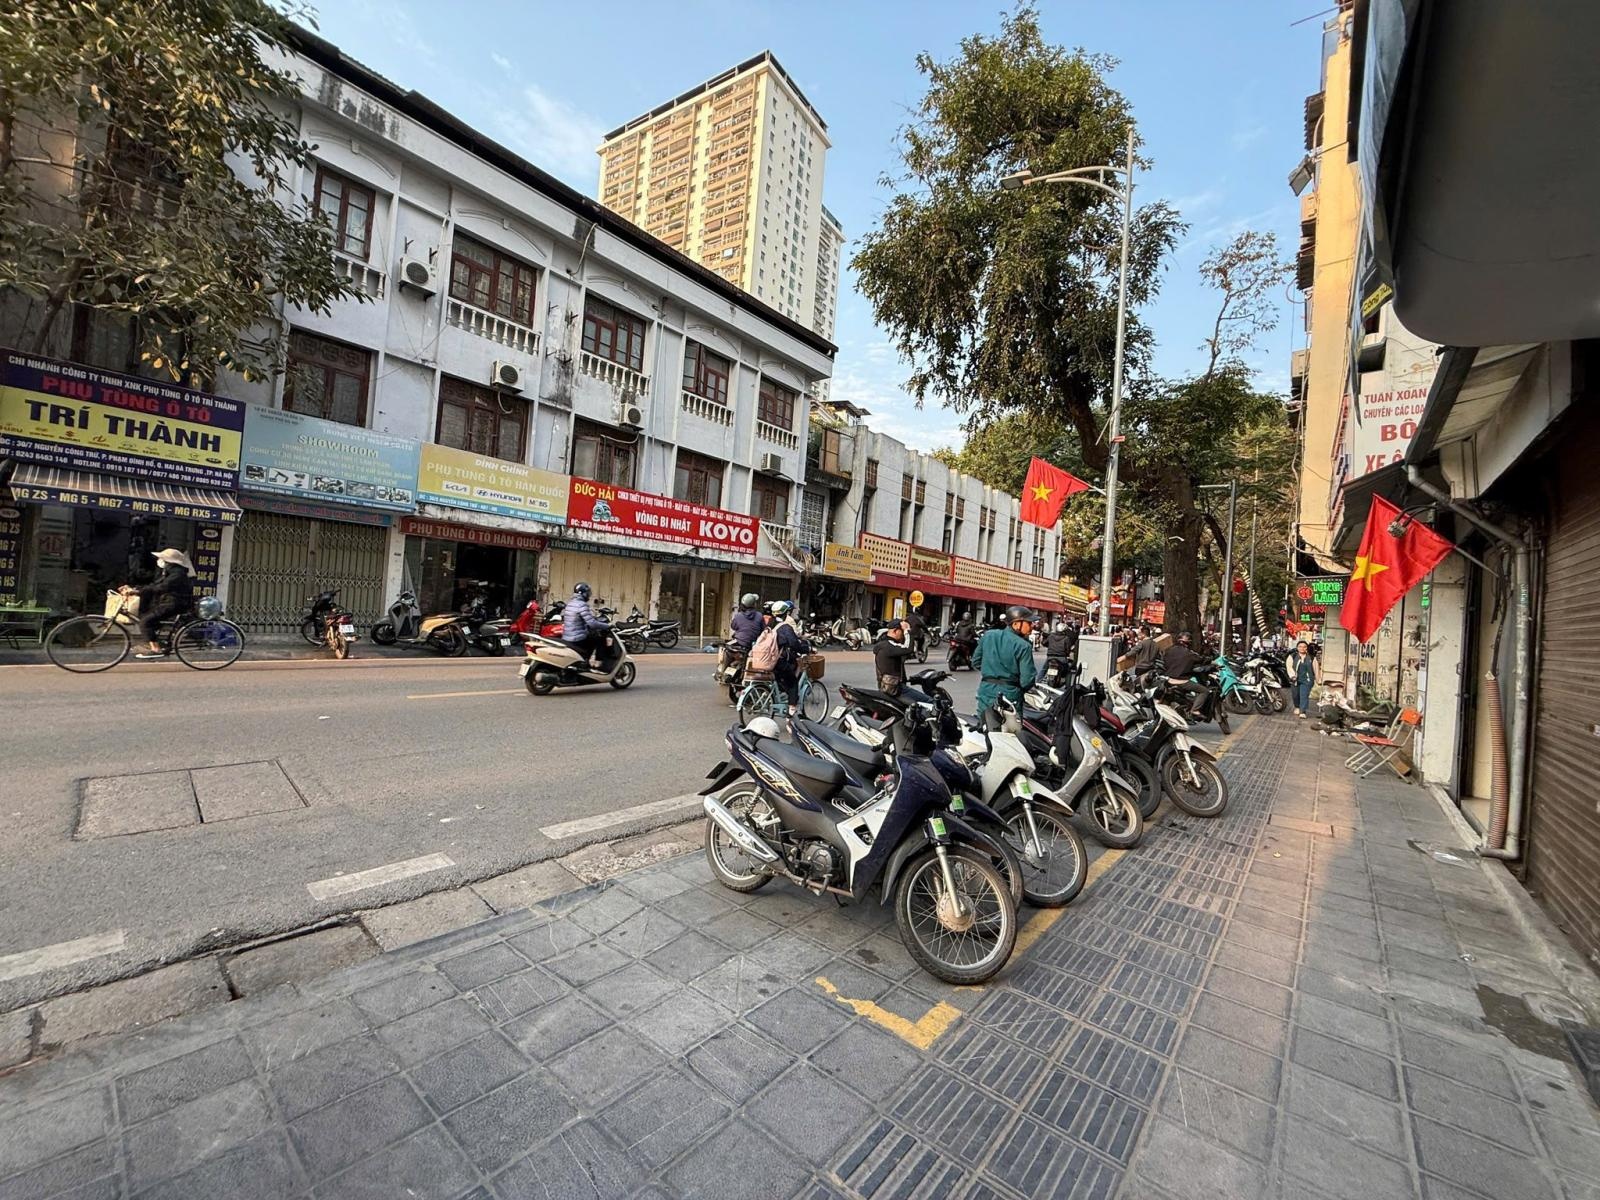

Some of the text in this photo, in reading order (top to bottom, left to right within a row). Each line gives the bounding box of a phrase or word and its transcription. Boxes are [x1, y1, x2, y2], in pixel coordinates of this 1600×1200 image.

[8, 355, 25, 366] CHI
[27, 358, 60, 373] NHÁNH
[62, 366, 86, 379] CÔNG
[88, 372, 99, 381] TY
[101, 375, 122, 387] TNHH
[124, 380, 141, 391] XNK
[161, 388, 180, 400] TÙNG
[184, 393, 189, 402] Ô
[192, 395, 200, 403] TÔ
[202, 396, 213, 406] TRÍ
[42, 376, 211, 422] PHỤ TÙNG Ô TÔ
[24, 399, 221, 452] TRÍ THÀNH
[65, 447, 84, 456] CÔNG
[297, 434, 379, 458] SHOWROOM
[74, 458, 101, 468] HOTLINE
[500, 464, 529, 477] CHÍNH
[455, 468, 486, 482] TÙNG
[489, 472, 496, 484] Ô
[500, 478, 513, 488] TÔ
[490, 492, 522, 502] HYUNDAI
[574, 482, 615, 500] ĐỨC HẢI
[32, 490, 48, 500] ZS
[60, 492, 78, 503] MG
[81, 495, 88, 504] 5
[98, 497, 122, 508] MG7
[133, 501, 149, 511] MG
[152, 503, 166, 513] HS
[175, 506, 190, 516] MG
[192, 508, 210, 518] RX5
[221, 512, 235, 521] MG
[9, 522, 20, 534] ZS
[593, 522, 611, 532] Nguyễn
[612, 525, 624, 534] Công
[635, 510, 691, 533] VÒNG BI NHẬT
[436, 524, 464, 538] TÙNG
[699, 520, 753, 544] KOYO
[10, 541, 16, 551] 7
[551, 540, 578, 550] TRUNG
[580, 544, 597, 552] TÂM
[599, 546, 620, 555] VÒNG
[8, 559, 14, 568] 5
[4, 576, 15, 586] HS
[1312, 581, 1340, 592] TÙNG
[1315, 592, 1338, 602] LÂM
